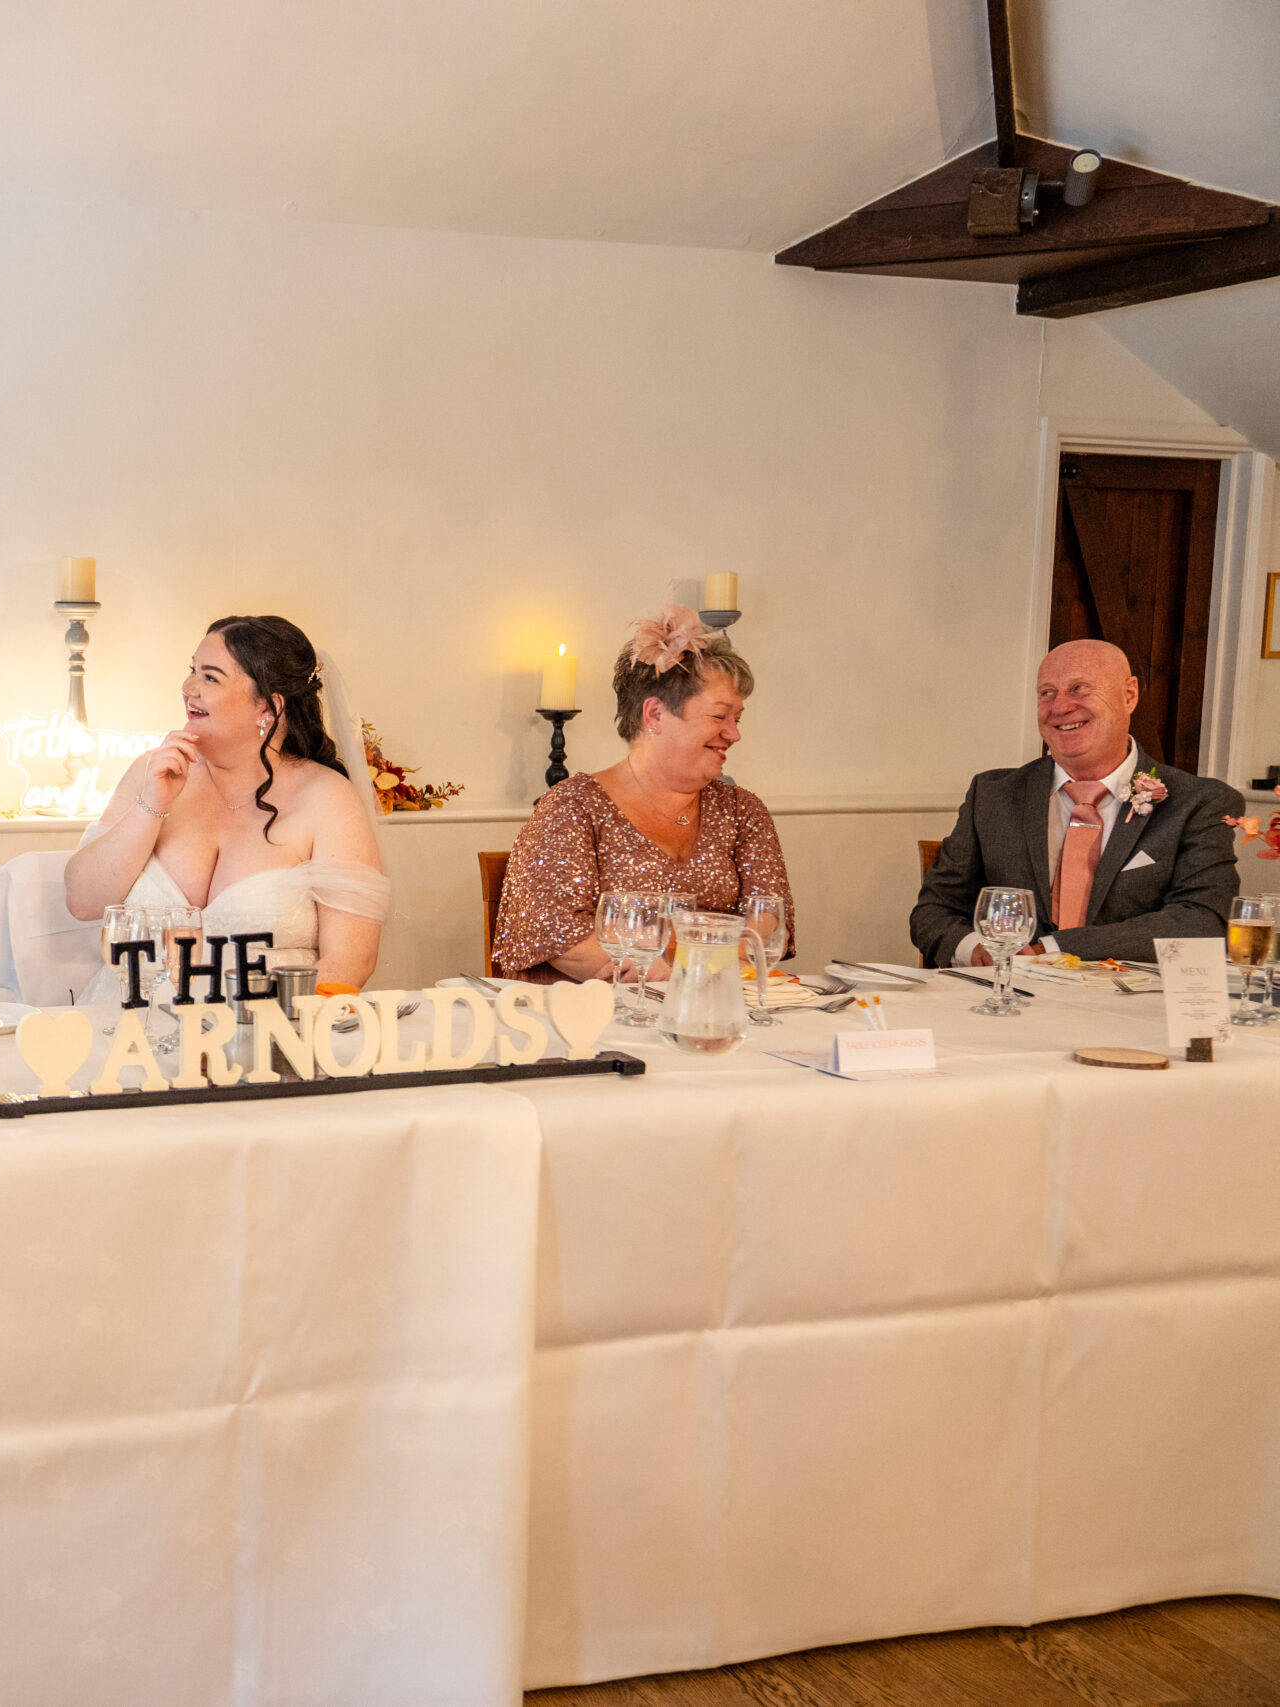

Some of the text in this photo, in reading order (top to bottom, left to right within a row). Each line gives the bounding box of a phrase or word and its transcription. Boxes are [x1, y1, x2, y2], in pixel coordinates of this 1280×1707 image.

[3, 714, 46, 762] To
[42, 713, 96, 758] the
[24, 767, 90, 815] and
[111, 932, 278, 1009] THE
[1179, 967, 1210, 977] MENU
[90, 983, 548, 1095] ARNOLDS
